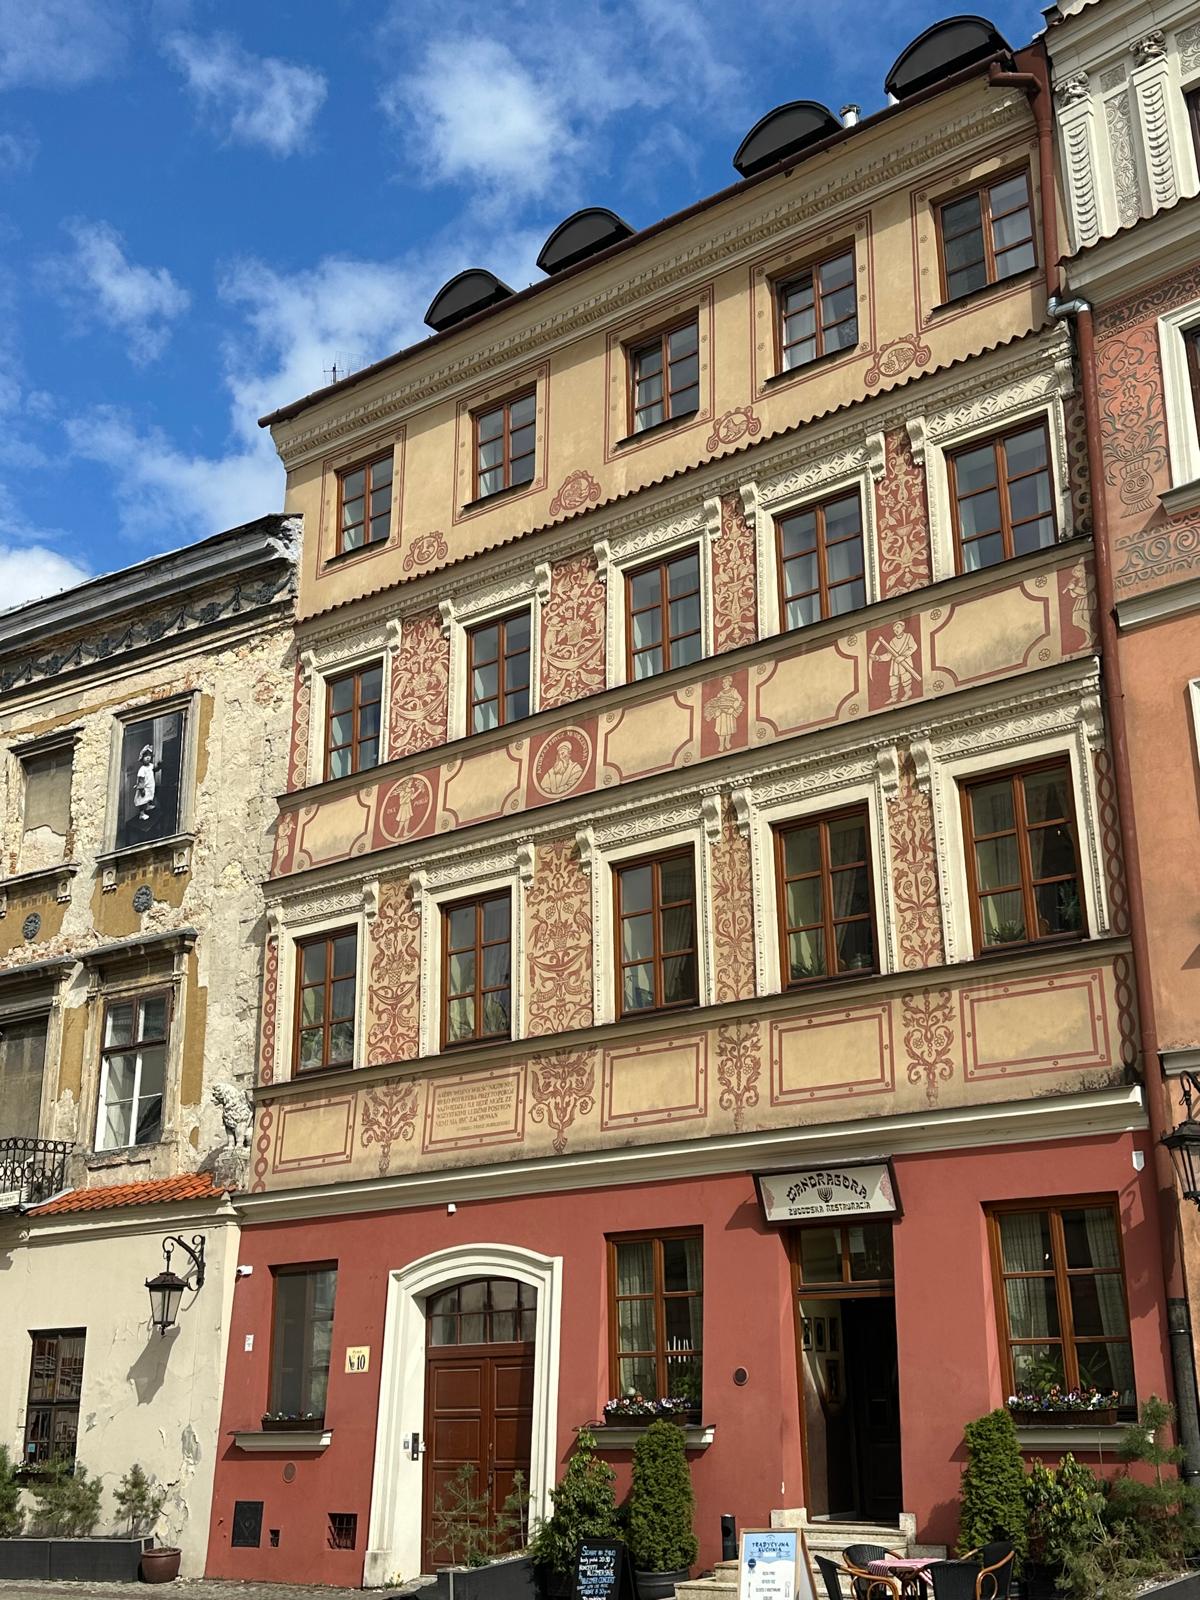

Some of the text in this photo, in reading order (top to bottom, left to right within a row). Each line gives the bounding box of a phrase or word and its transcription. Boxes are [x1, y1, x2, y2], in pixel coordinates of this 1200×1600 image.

[786, 1172, 868, 1204] MANDRAGORA
[826, 1201, 871, 1213] RESTAURACJA
[357, 1354, 365, 1370] 10
